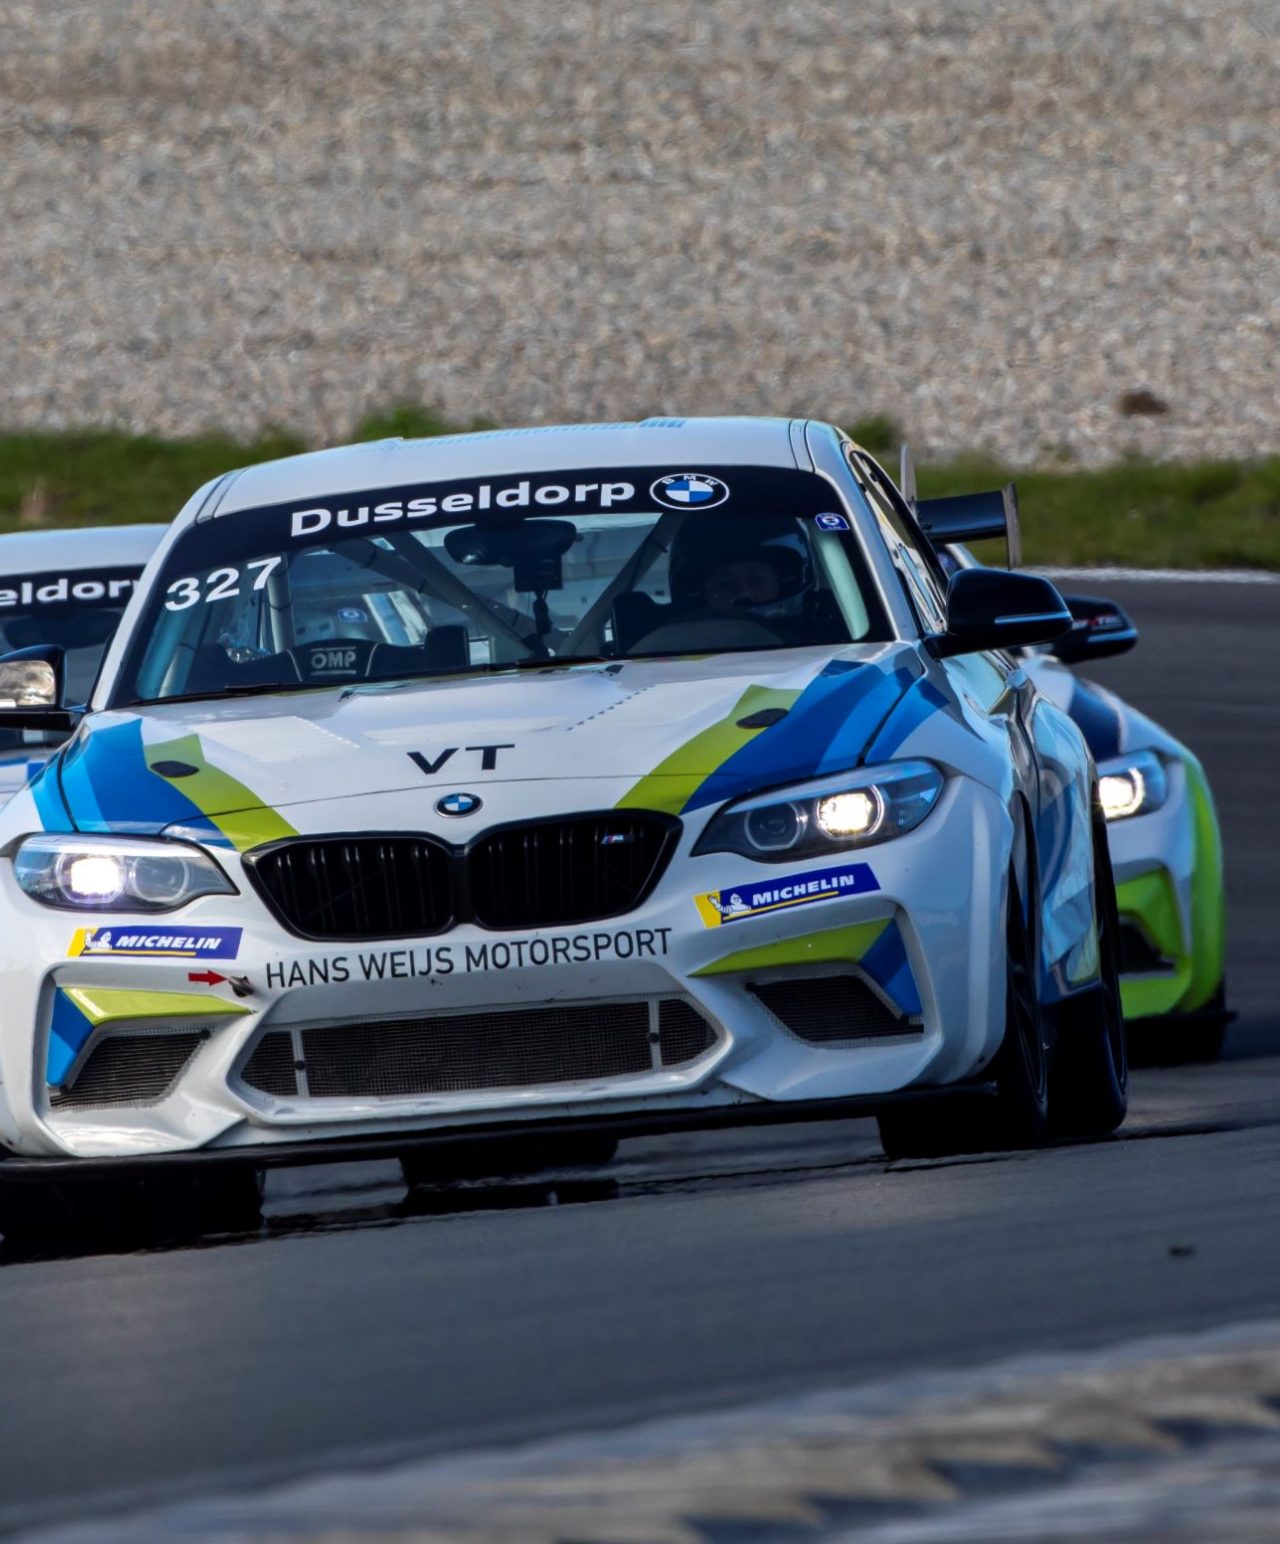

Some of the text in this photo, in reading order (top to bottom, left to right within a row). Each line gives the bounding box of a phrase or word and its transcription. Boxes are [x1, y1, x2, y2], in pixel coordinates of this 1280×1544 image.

[662, 474, 718, 487] BMW
[291, 481, 635, 537] Dusseldorp
[165, 556, 282, 611] 327
[311, 651, 357, 669] OMP
[406, 743, 516, 775] VT
[752, 873, 855, 906] MICHELIN
[116, 934, 222, 950] MICHELIN
[266, 927, 673, 988] HANS WEIJS MOTORSPORT
